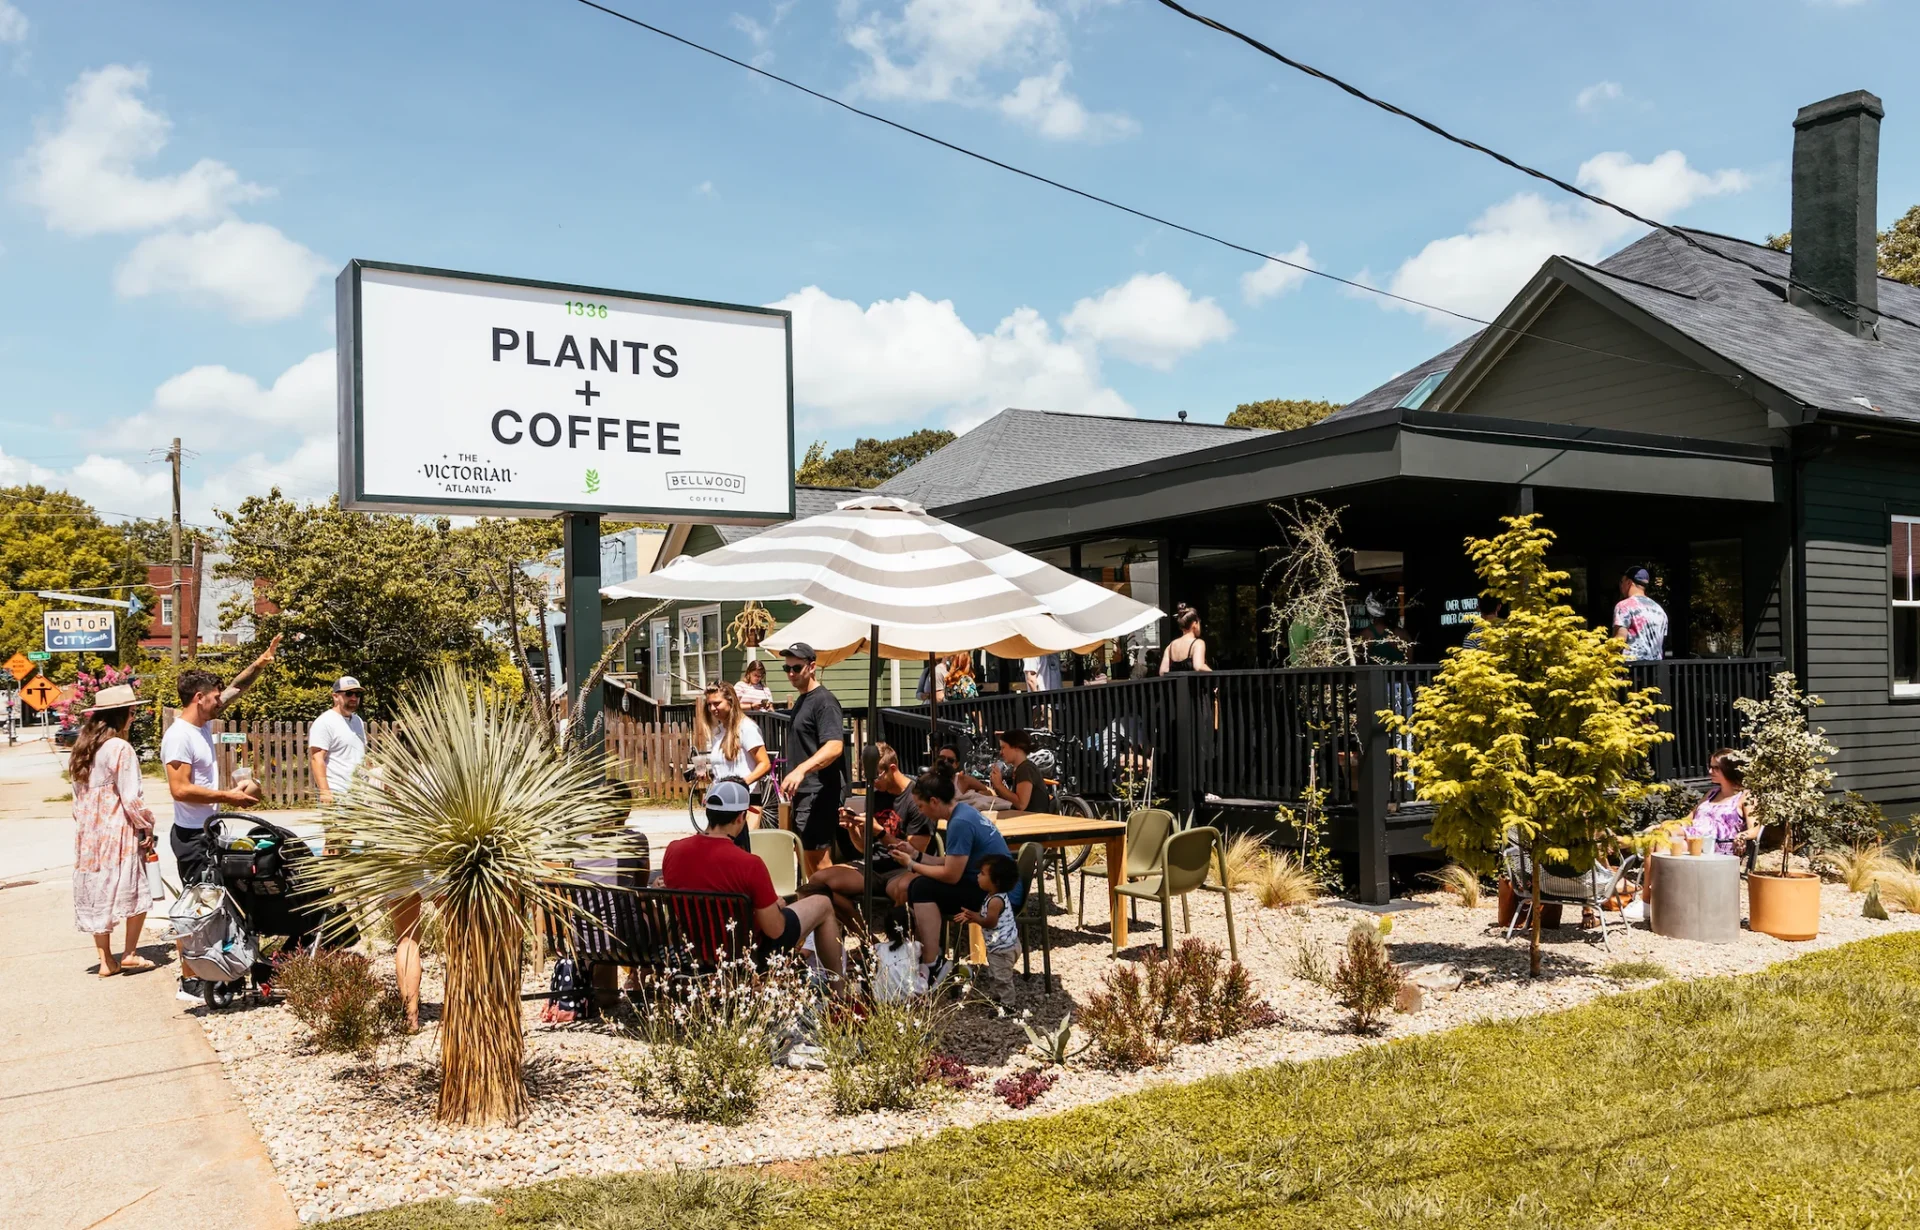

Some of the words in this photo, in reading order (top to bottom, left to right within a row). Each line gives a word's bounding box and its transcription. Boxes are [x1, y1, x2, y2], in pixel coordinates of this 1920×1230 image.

[565, 301, 608, 319] 1336
[492, 327, 679, 378] PLANTS
[575, 381, 600, 406] +
[491, 409, 681, 455] COFFEE
[458, 453, 478, 463] THE
[424, 464, 512, 482] VICTORIAN
[445, 483, 492, 494] ATLANTA
[671, 475, 741, 489] BELLWOOD
[50, 617, 107, 630] MOTOR
[53, 635, 87, 645] CITY
[86, 633, 108, 645] South
